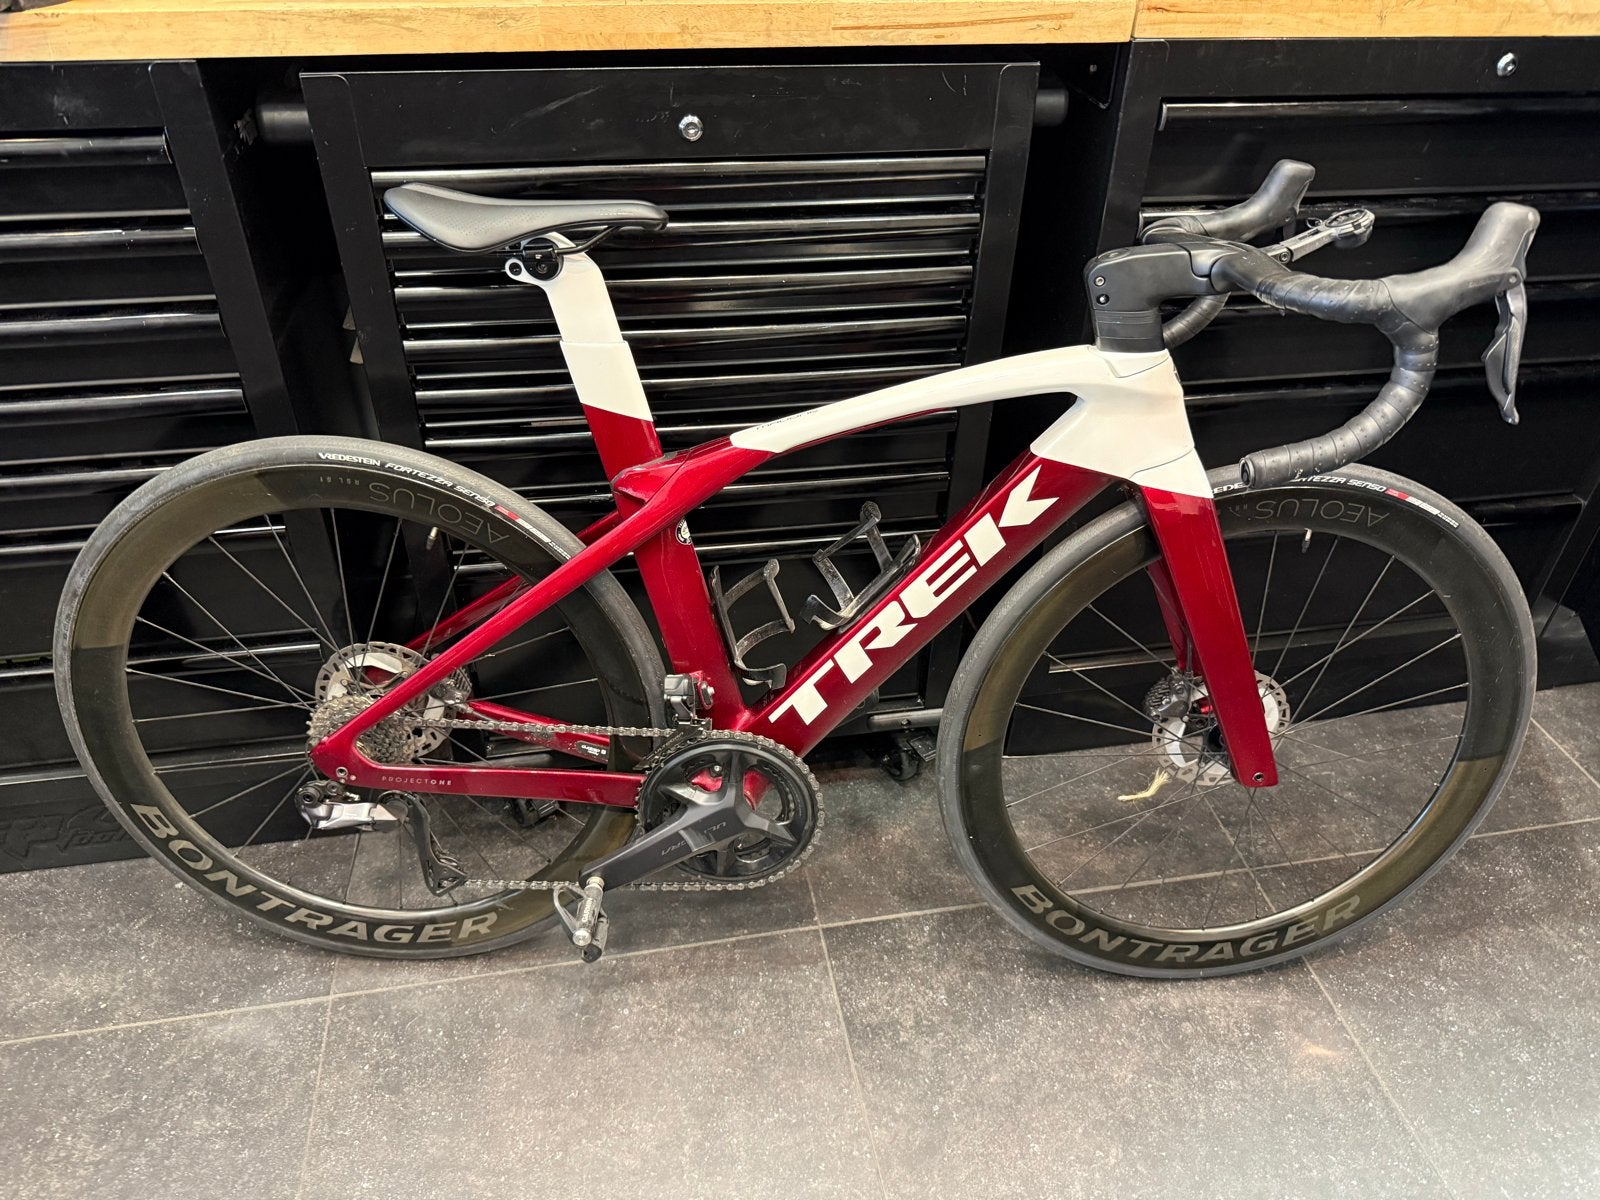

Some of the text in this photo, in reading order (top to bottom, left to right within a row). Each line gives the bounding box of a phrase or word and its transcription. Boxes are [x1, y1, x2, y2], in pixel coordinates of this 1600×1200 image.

[318, 452, 496, 507] VREDESTEIN FORTEZZA SENSO
[1346, 479, 1387, 493] SENSO
[368, 481, 511, 544] AEOLUS
[1254, 498, 1390, 528] AEOLUS
[768, 464, 1060, 726] TREK
[130, 803, 499, 945] BONTRAGER
[1010, 884, 1362, 964] BONTRAGER
